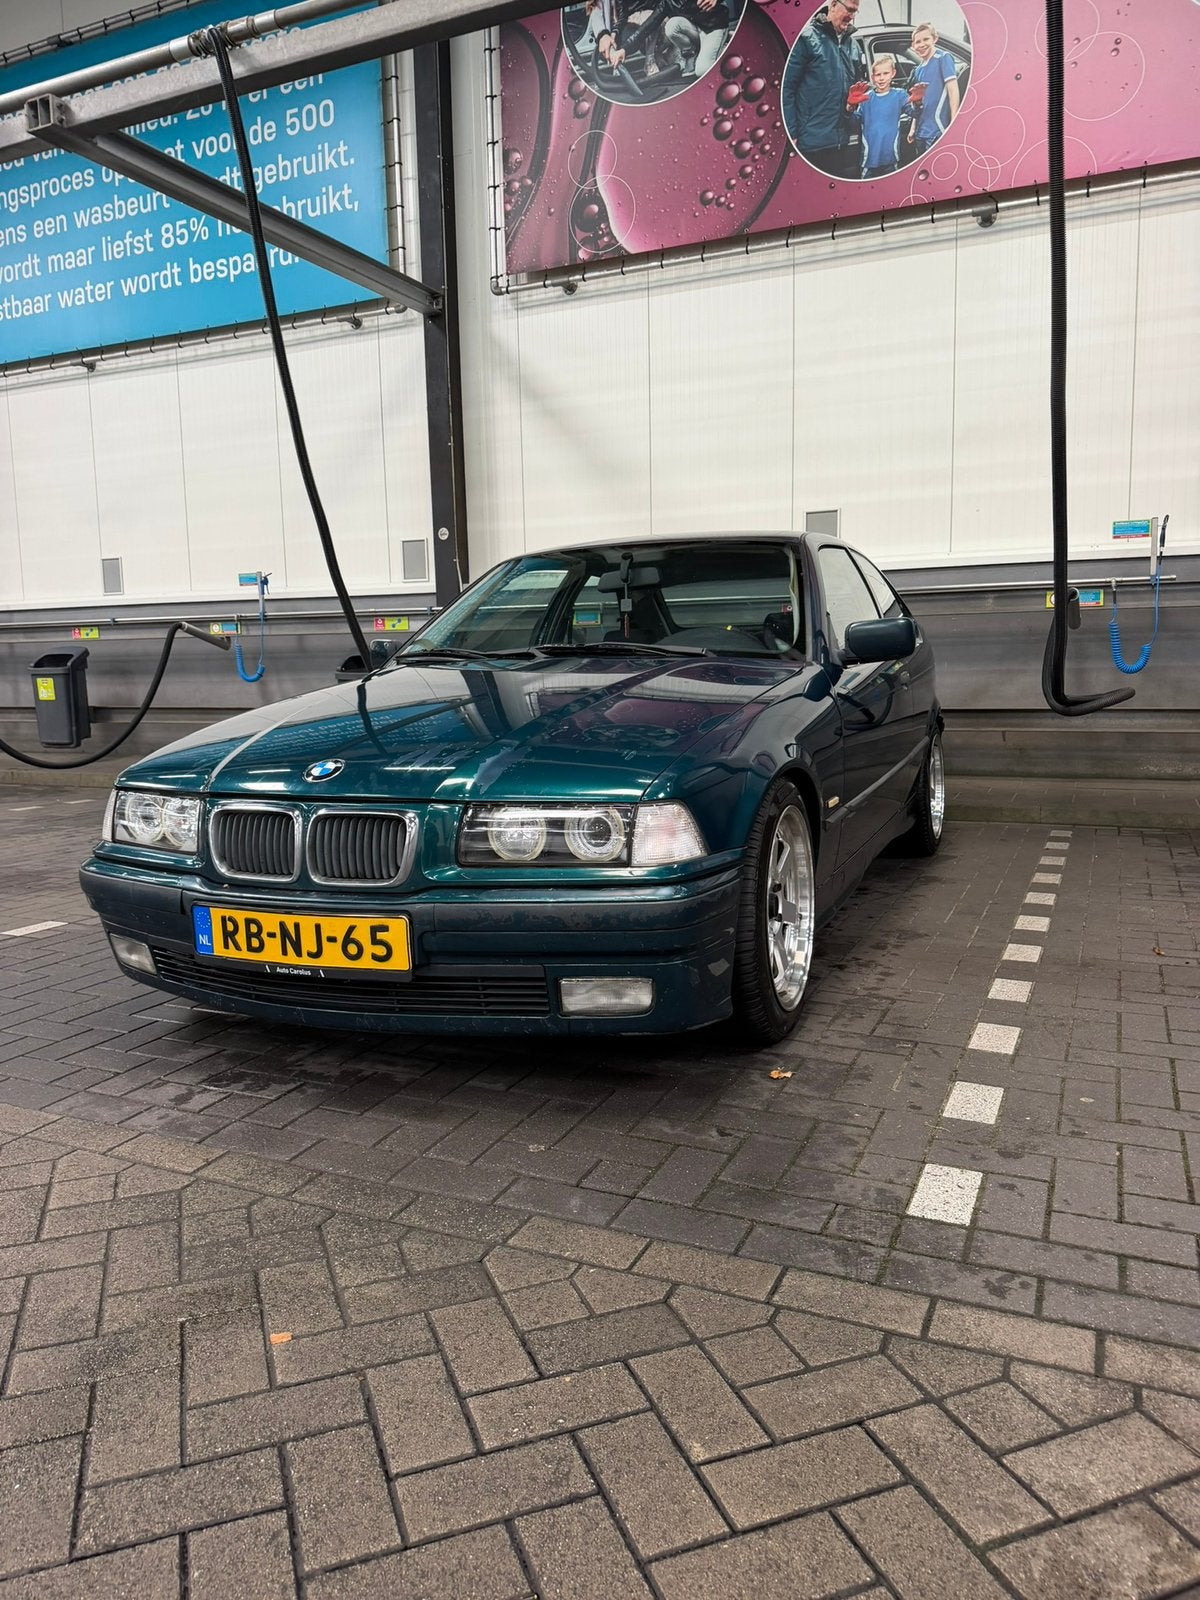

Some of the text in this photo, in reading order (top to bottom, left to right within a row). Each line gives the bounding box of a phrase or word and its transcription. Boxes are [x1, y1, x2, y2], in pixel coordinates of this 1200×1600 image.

[248, 116, 276, 146] de
[286, 99, 335, 137] 500
[33, 213, 68, 239] een
[73, 187, 170, 229] wasbeurt
[253, 139, 355, 194] gebruikt.
[0, 253, 42, 284] ordt
[47, 245, 96, 273] maar
[101, 227, 154, 262] liefst
[160, 214, 210, 250] 85%
[57, 279, 114, 309] water
[120, 261, 183, 297] wordt
[189, 246, 300, 285] bespard.
[198, 933, 212, 947] NL
[220, 914, 394, 963] RB-NJ-65
[276, 966, 289, 974] Auto
